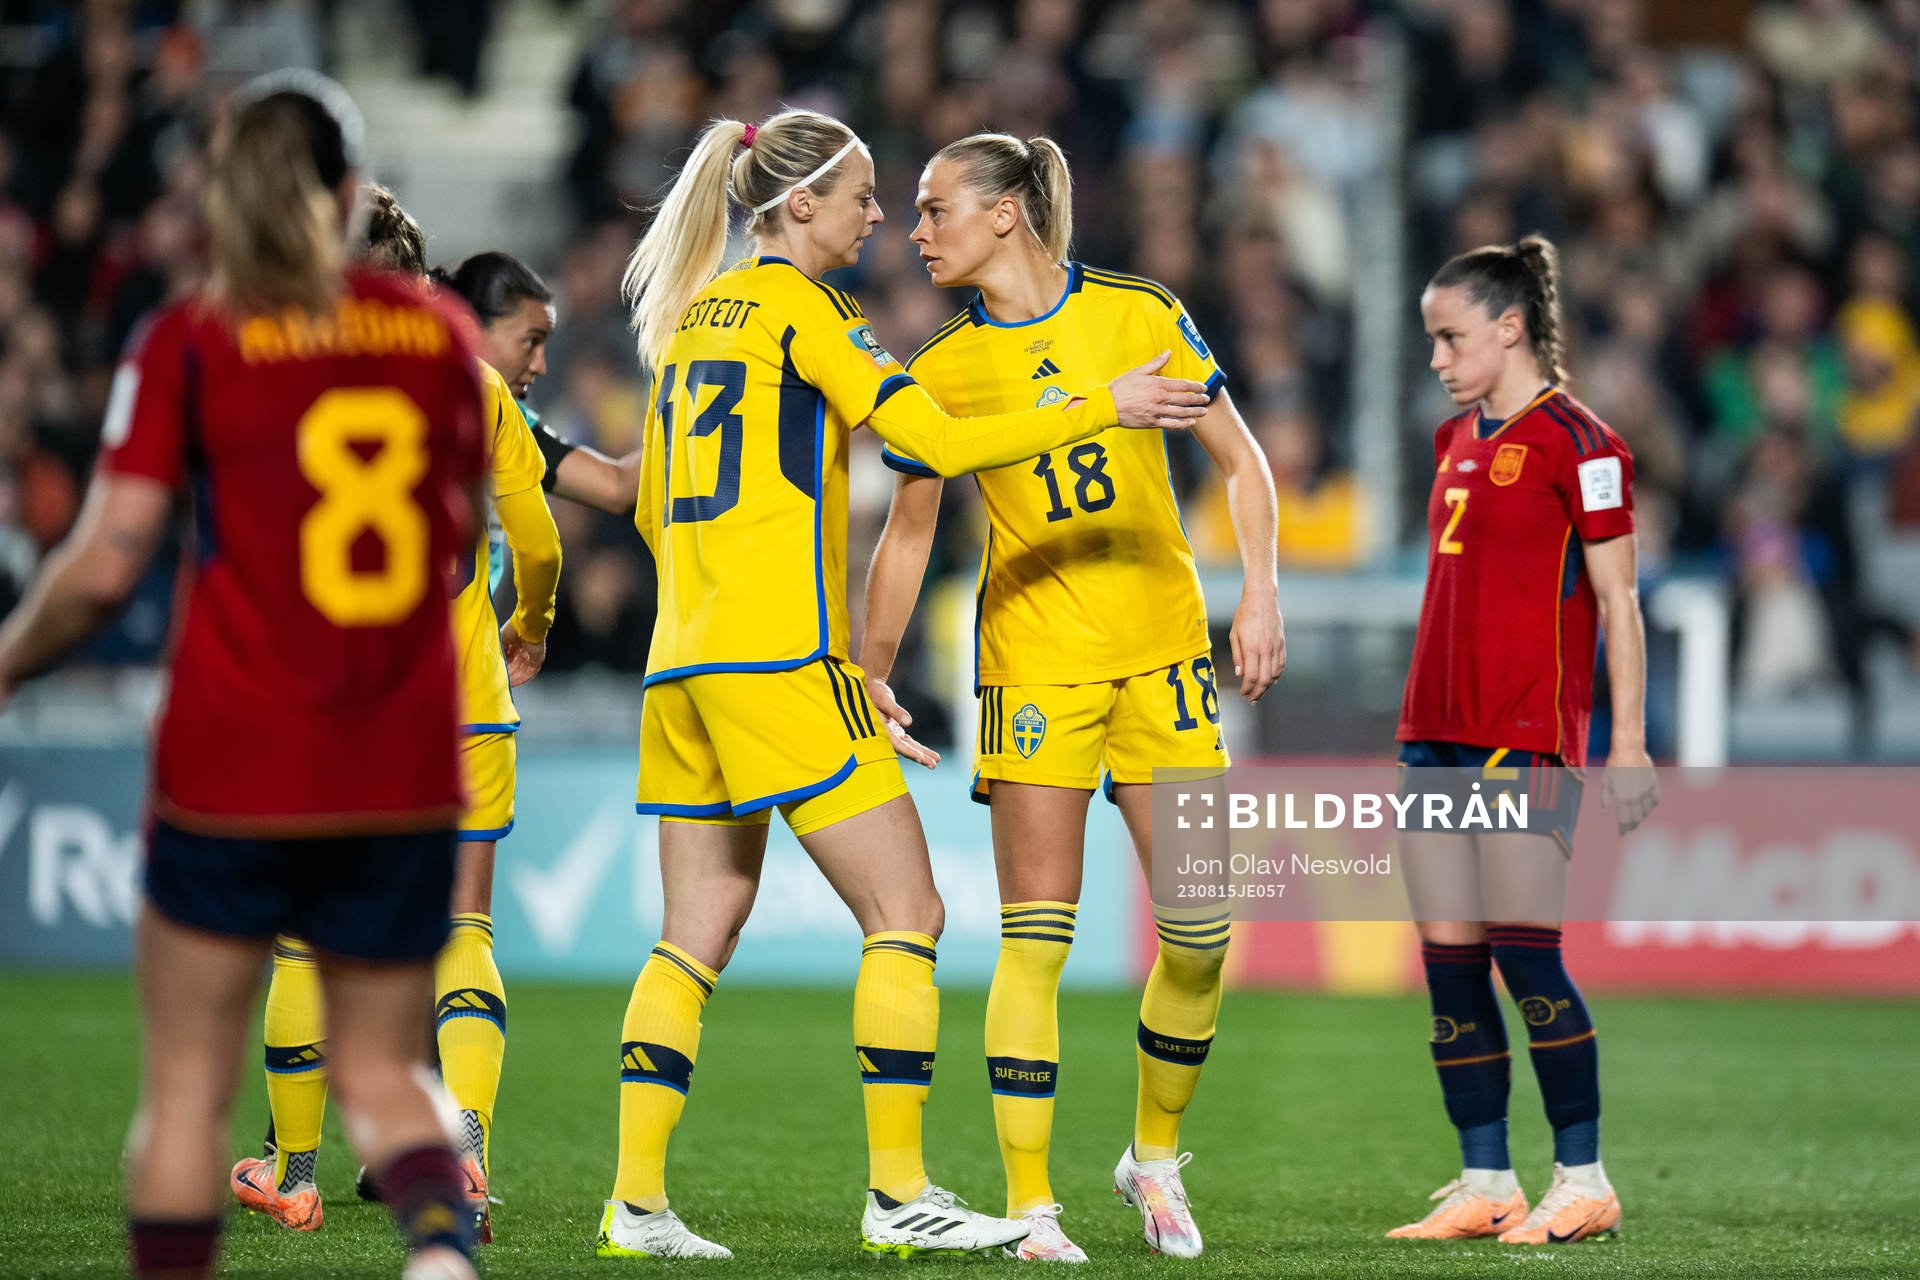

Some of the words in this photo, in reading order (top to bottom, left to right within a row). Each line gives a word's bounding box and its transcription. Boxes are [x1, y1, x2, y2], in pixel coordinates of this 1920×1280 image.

[673, 297, 760, 333] ESTEDT
[655, 360, 746, 528] 13
[1033, 442, 1116, 523] 18
[296, 386, 431, 628] 8
[1438, 487, 1469, 555] 2
[1166, 656, 1220, 731] 18
